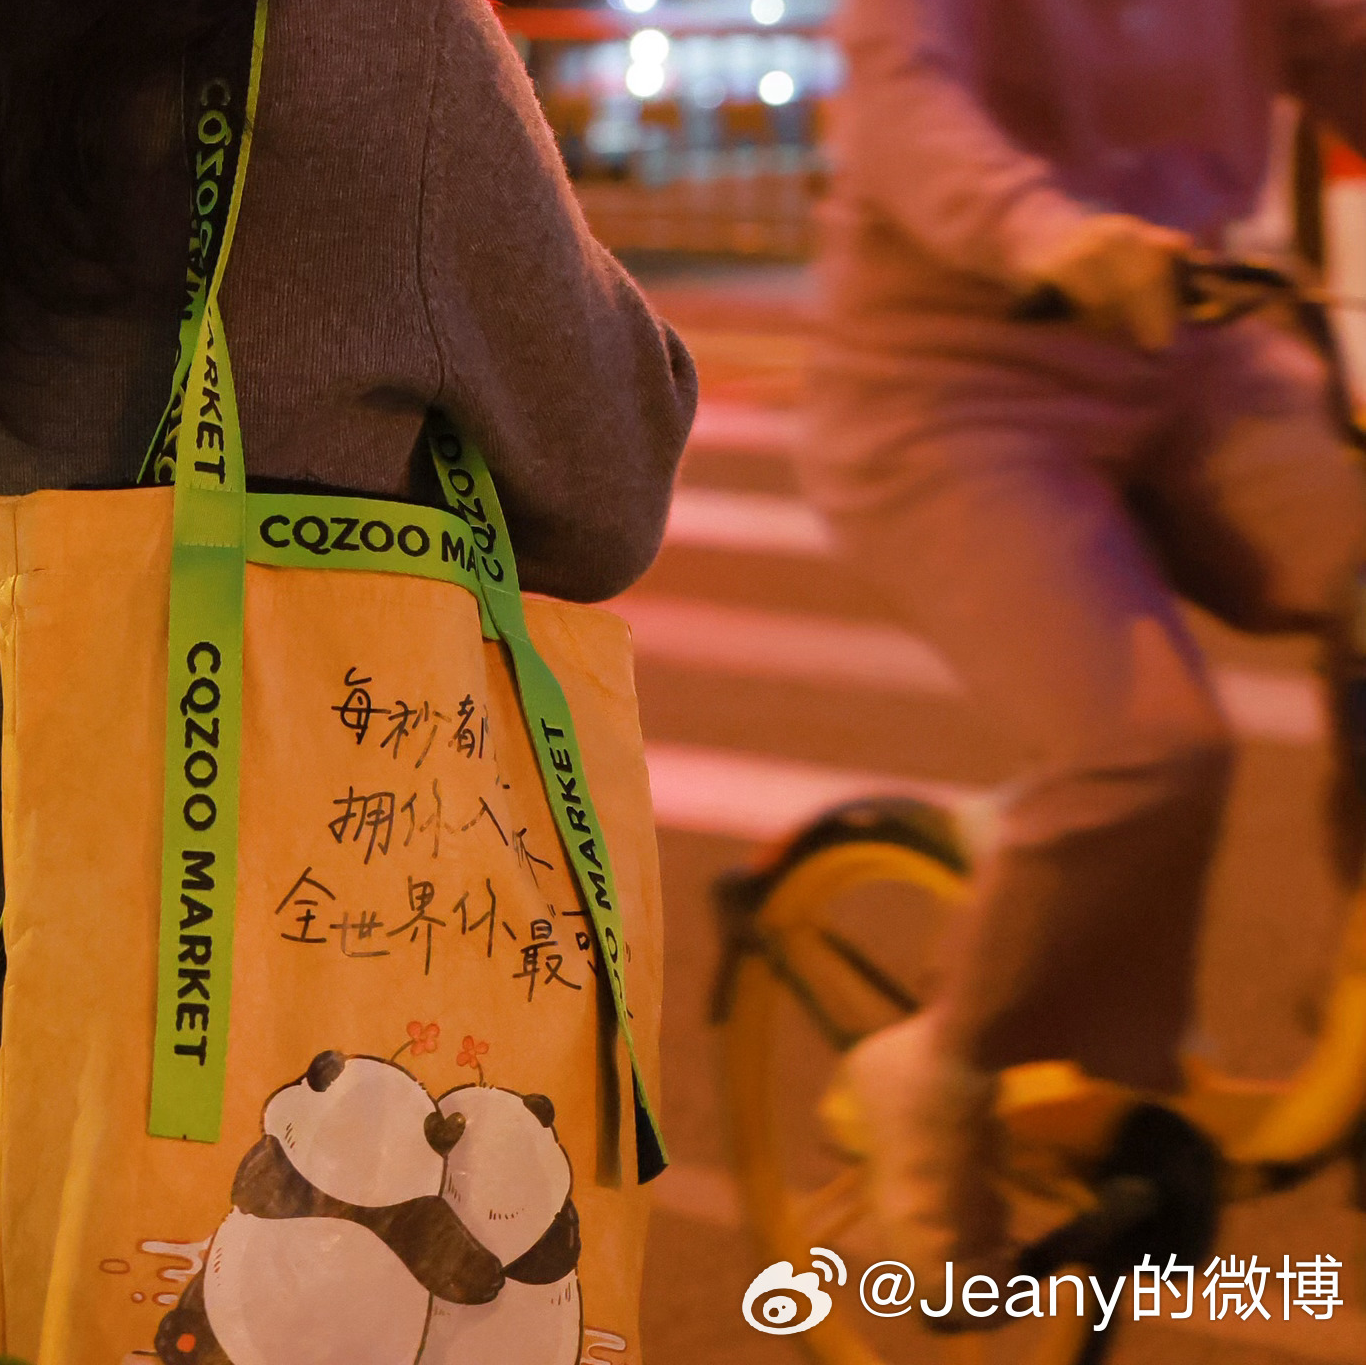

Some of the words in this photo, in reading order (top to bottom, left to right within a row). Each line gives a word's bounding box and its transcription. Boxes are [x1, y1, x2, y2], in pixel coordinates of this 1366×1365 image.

[259, 514, 431, 558] CQZOO
[179, 640, 222, 832] CQZOO
[331, 666, 511, 789] 每秒都
[540, 717, 613, 912] MARKET
[173, 849, 216, 1067] MARKET
